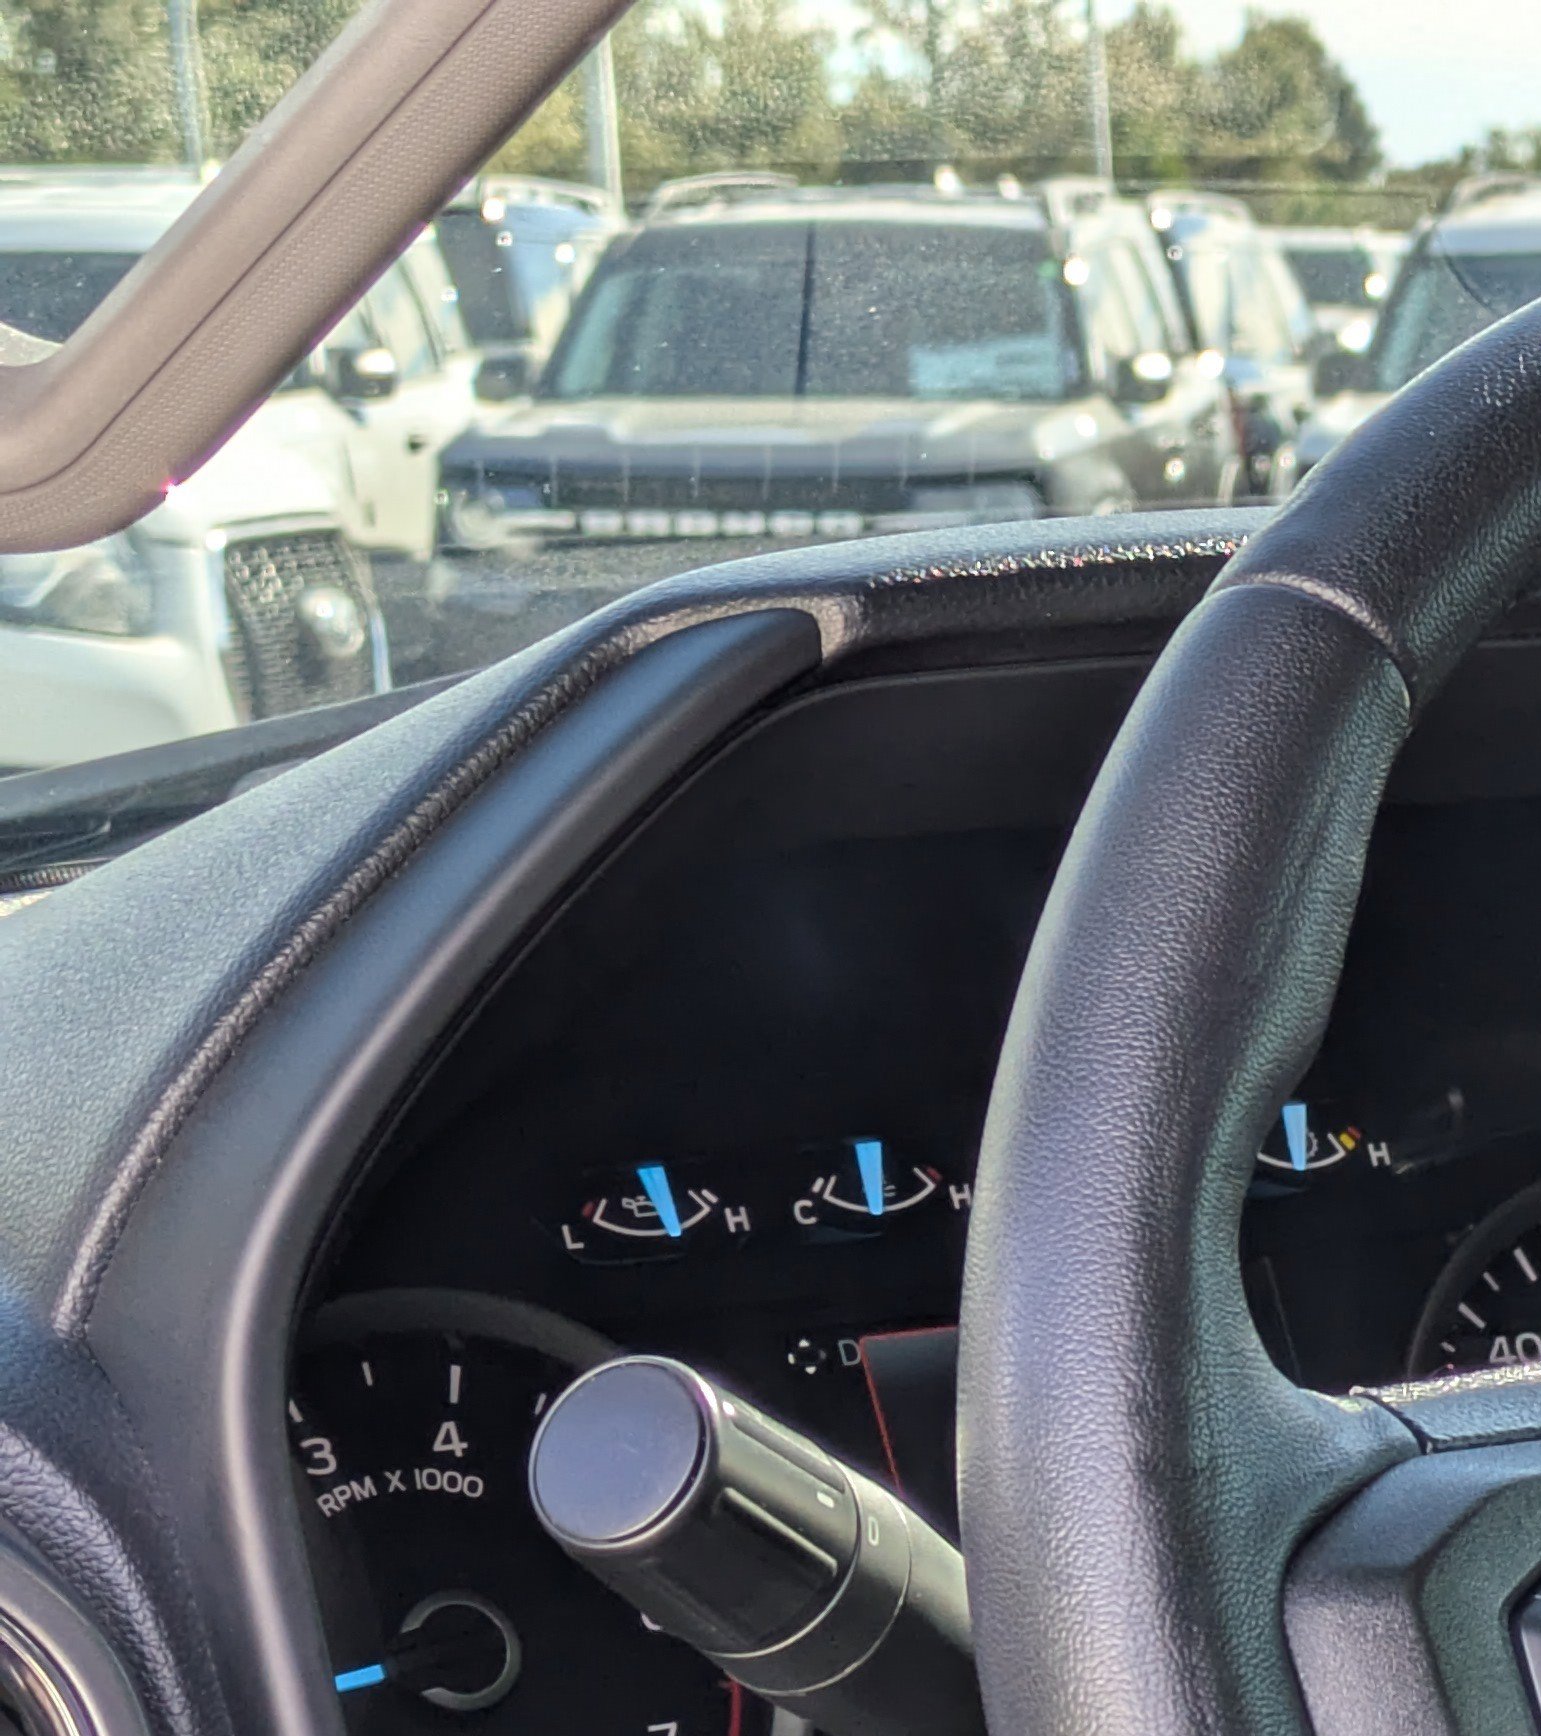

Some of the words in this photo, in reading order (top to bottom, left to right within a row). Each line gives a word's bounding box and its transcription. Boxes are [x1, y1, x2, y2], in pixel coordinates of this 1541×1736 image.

[1367, 1142, 1391, 1168] H
[951, 1184, 970, 1210] H
[725, 1206, 750, 1233] H
[793, 1200, 818, 1225] C
[562, 1225, 584, 1250] L
[433, 1420, 469, 1458] 4
[300, 1437, 338, 1475] 3
[316, 1475, 378, 1518] RPM
[384, 1469, 407, 1493] X
[414, 1468, 484, 1498] 1000
